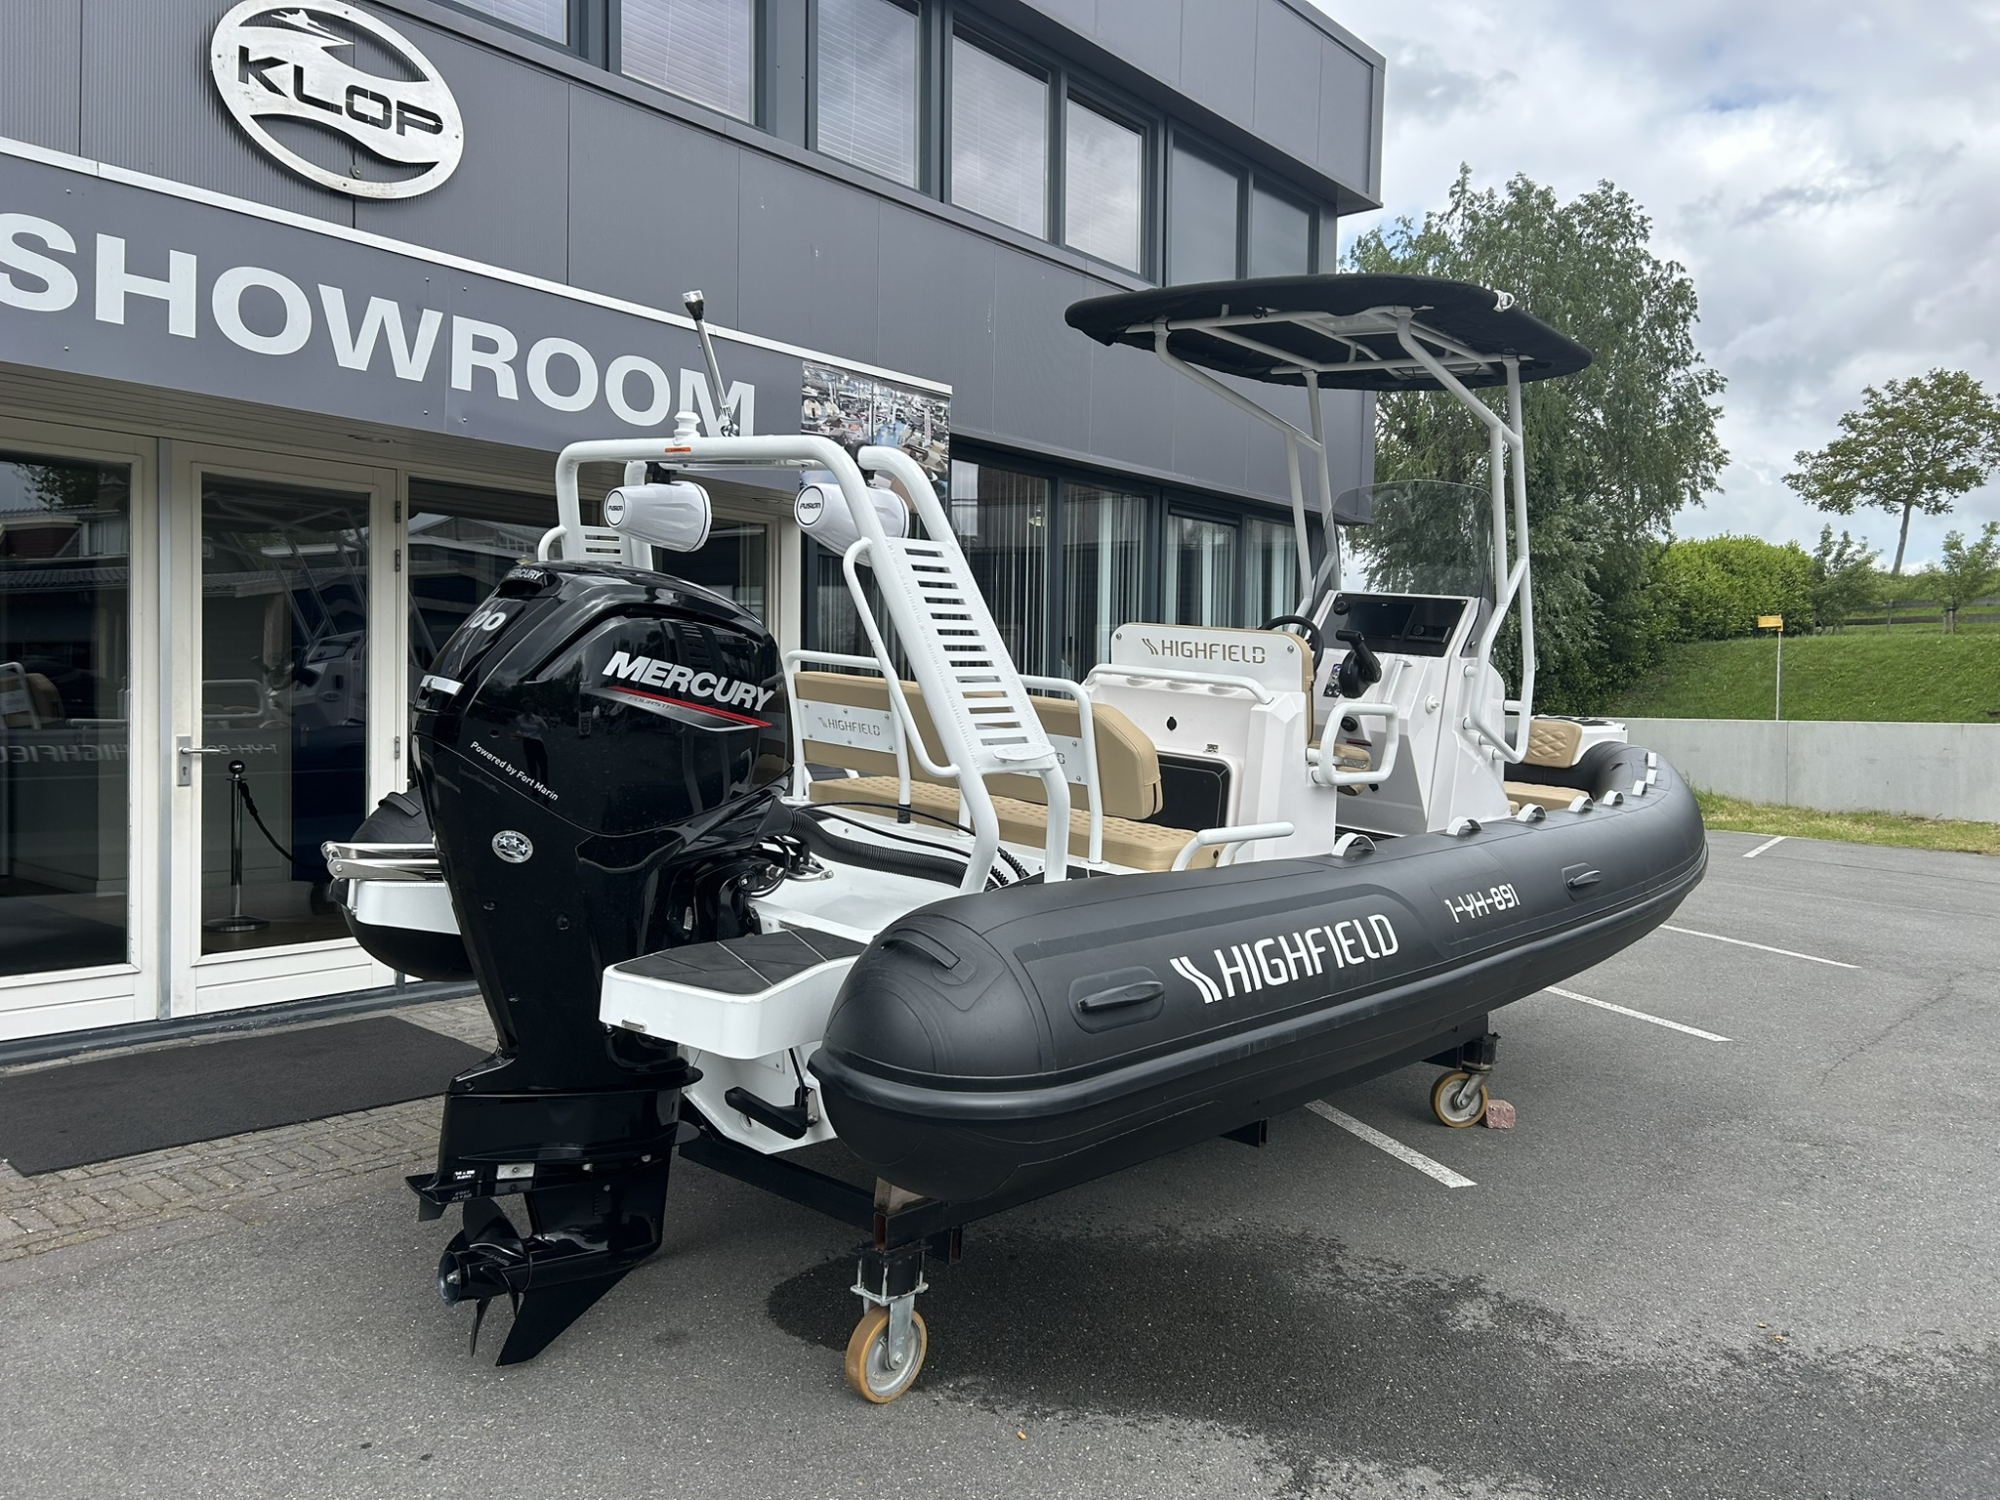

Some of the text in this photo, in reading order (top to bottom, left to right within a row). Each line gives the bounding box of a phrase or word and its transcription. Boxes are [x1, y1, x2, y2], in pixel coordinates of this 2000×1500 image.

[238, 45, 443, 137] KLOP
[0, 213, 755, 437] SHOWROOM
[602, 650, 775, 712] MERCURY
[1161, 639, 1266, 664] HIGHFIELD
[827, 718, 881, 737] HIGHFIELD
[470, 741, 559, 801] Powered by Fort Marin
[1444, 883, 1521, 924] 1-YH-891
[1214, 913, 1400, 998] HIGHFIELD
